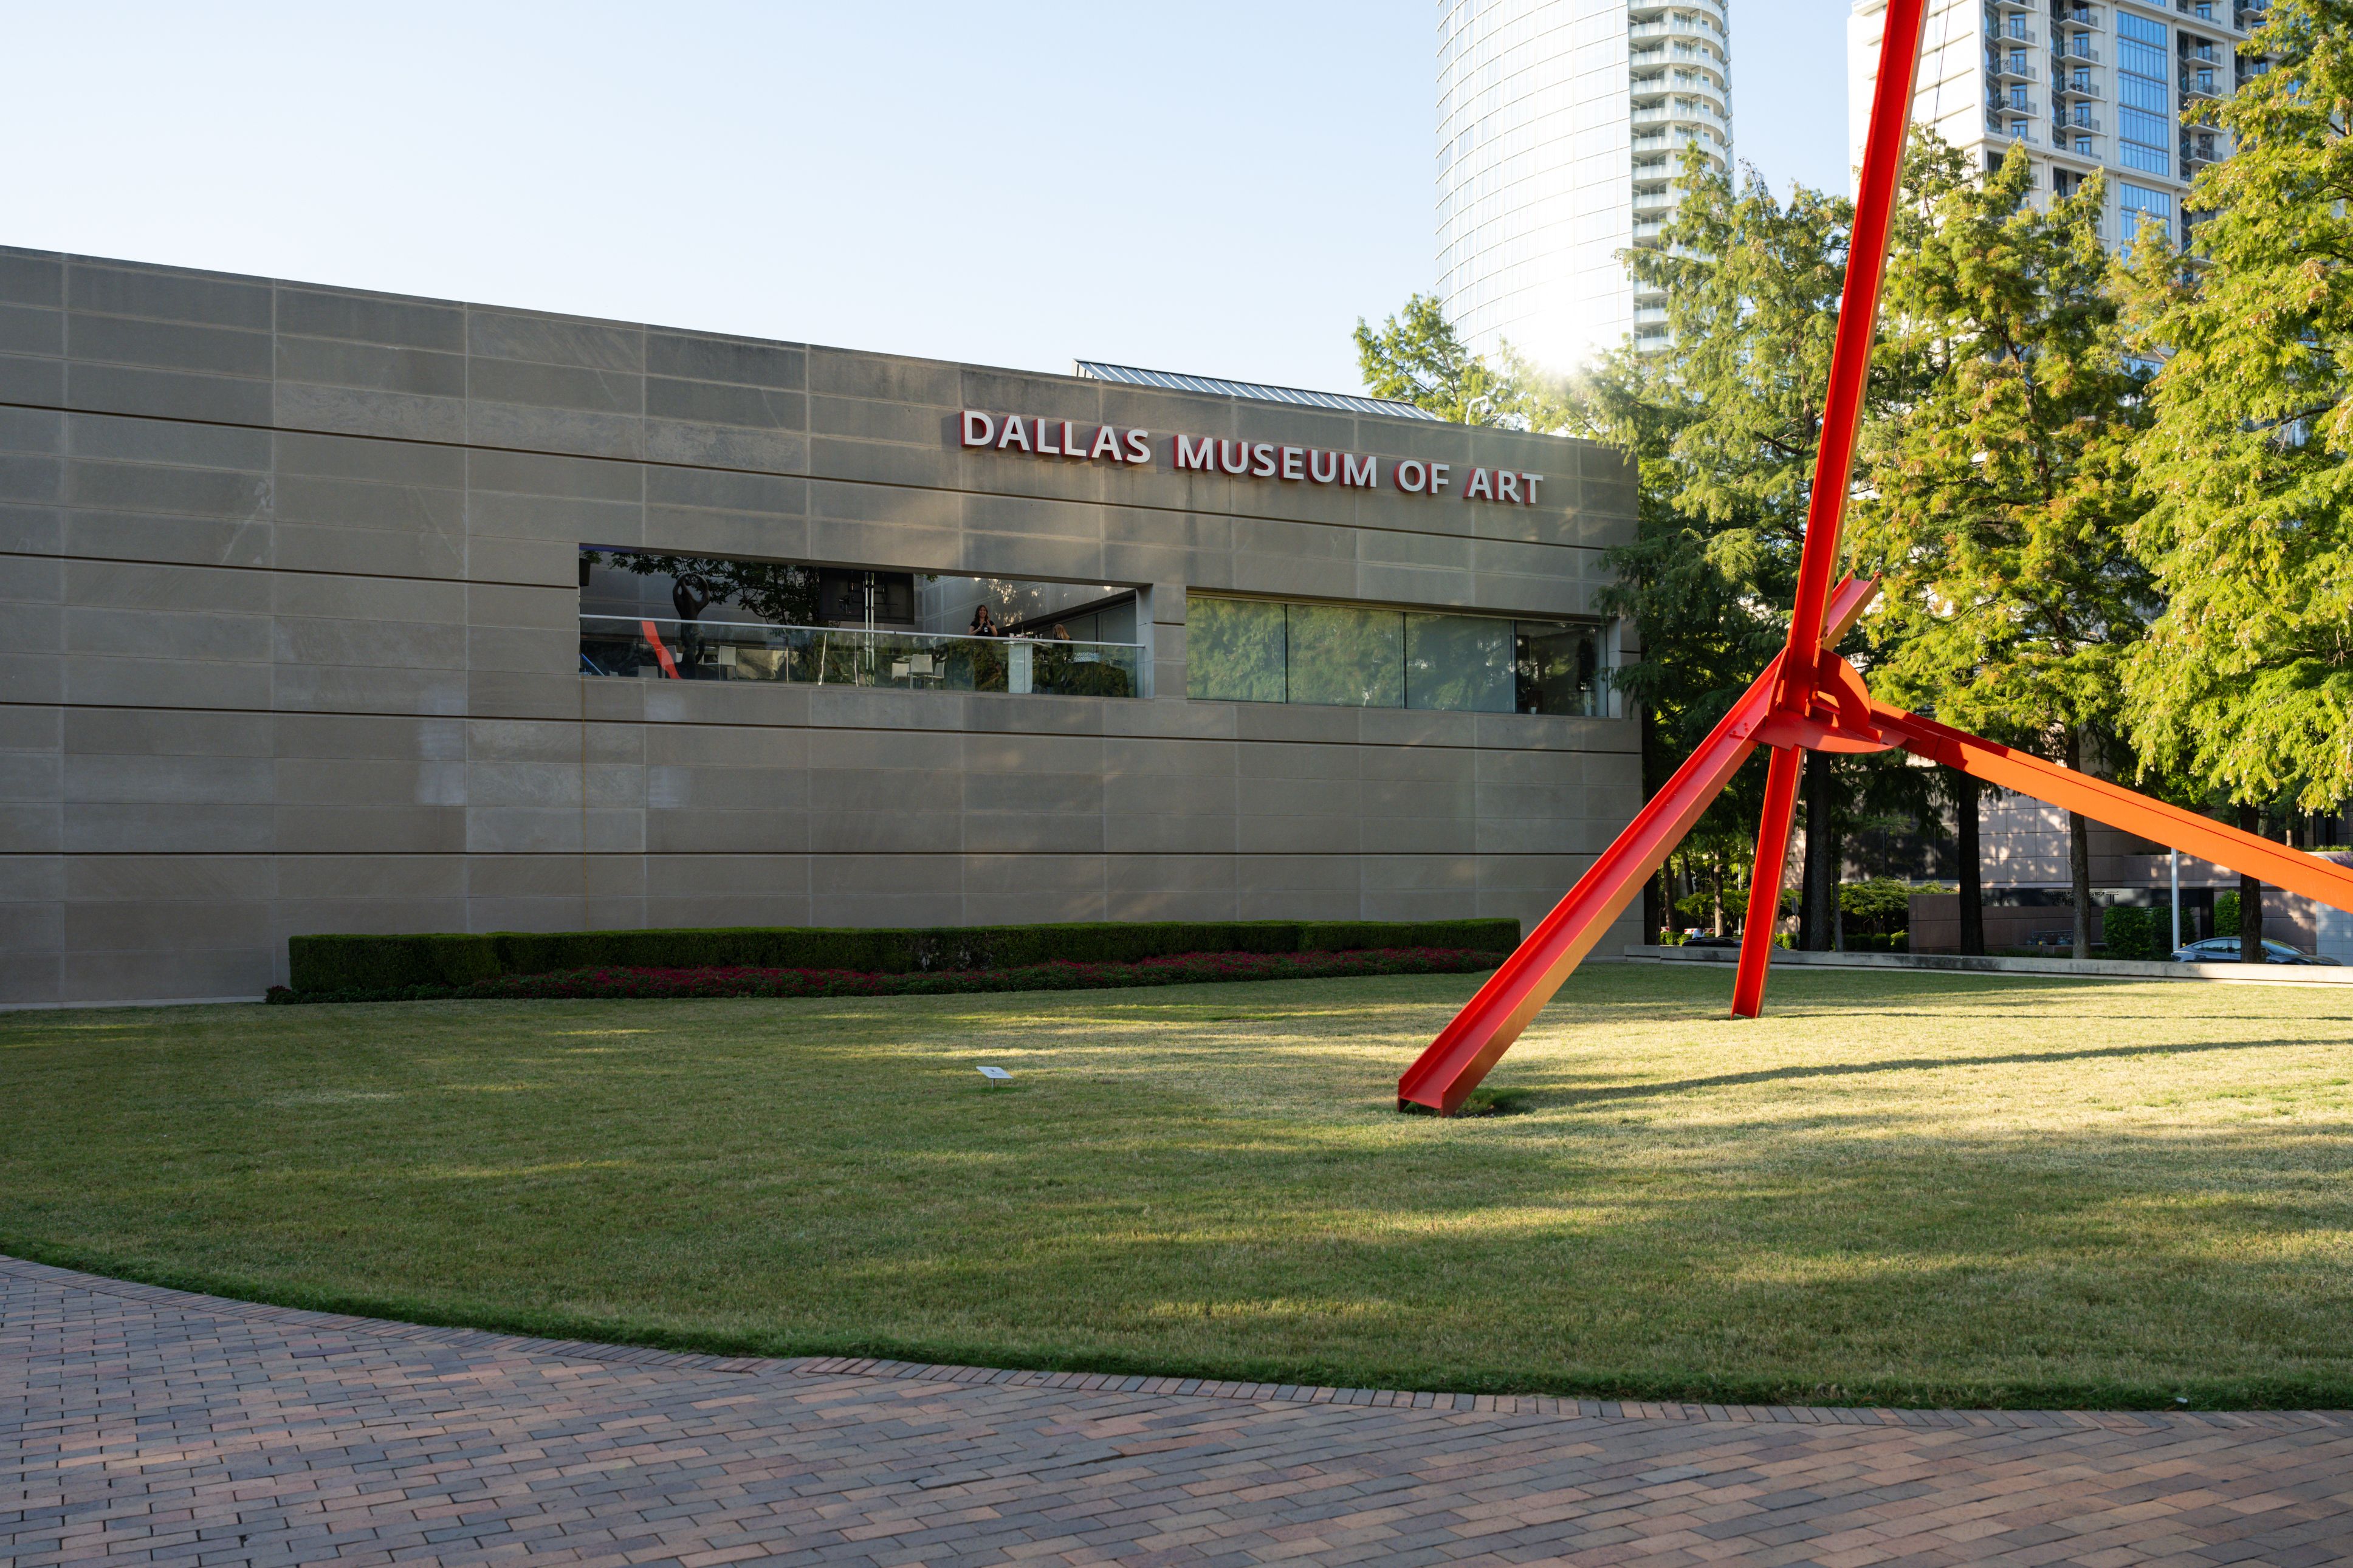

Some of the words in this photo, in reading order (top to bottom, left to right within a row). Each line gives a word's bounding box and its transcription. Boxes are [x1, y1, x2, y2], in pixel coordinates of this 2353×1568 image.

[960, 410, 1151, 464] DALLAS
[1173, 434, 1377, 489] MUSEUM
[1394, 460, 1449, 495] OF
[1463, 467, 1544, 505] ART
